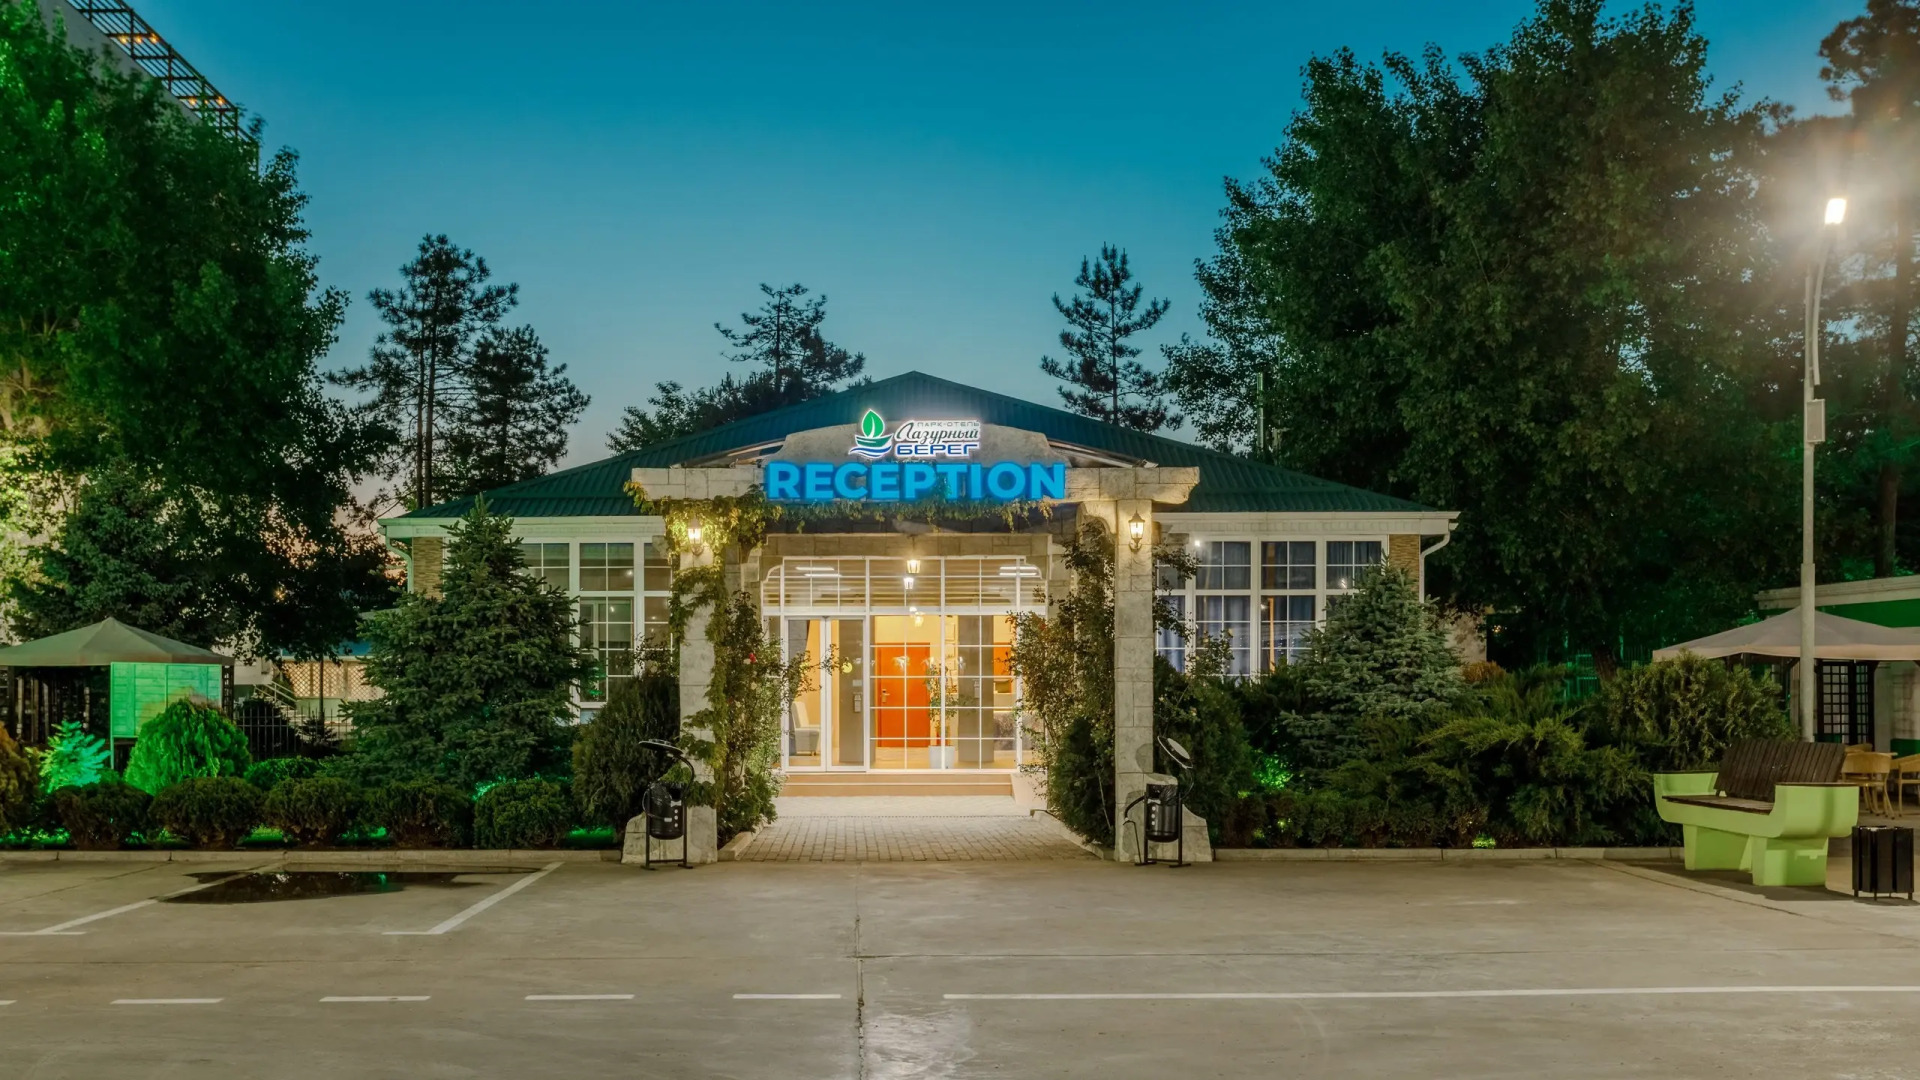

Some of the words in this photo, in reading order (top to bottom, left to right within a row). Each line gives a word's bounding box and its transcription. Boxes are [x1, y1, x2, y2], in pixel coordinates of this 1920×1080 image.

[896, 422, 979, 444] Лазурный
[897, 444, 978, 455] БЕРЕГ
[767, 461, 1066, 500] RECEPTION
